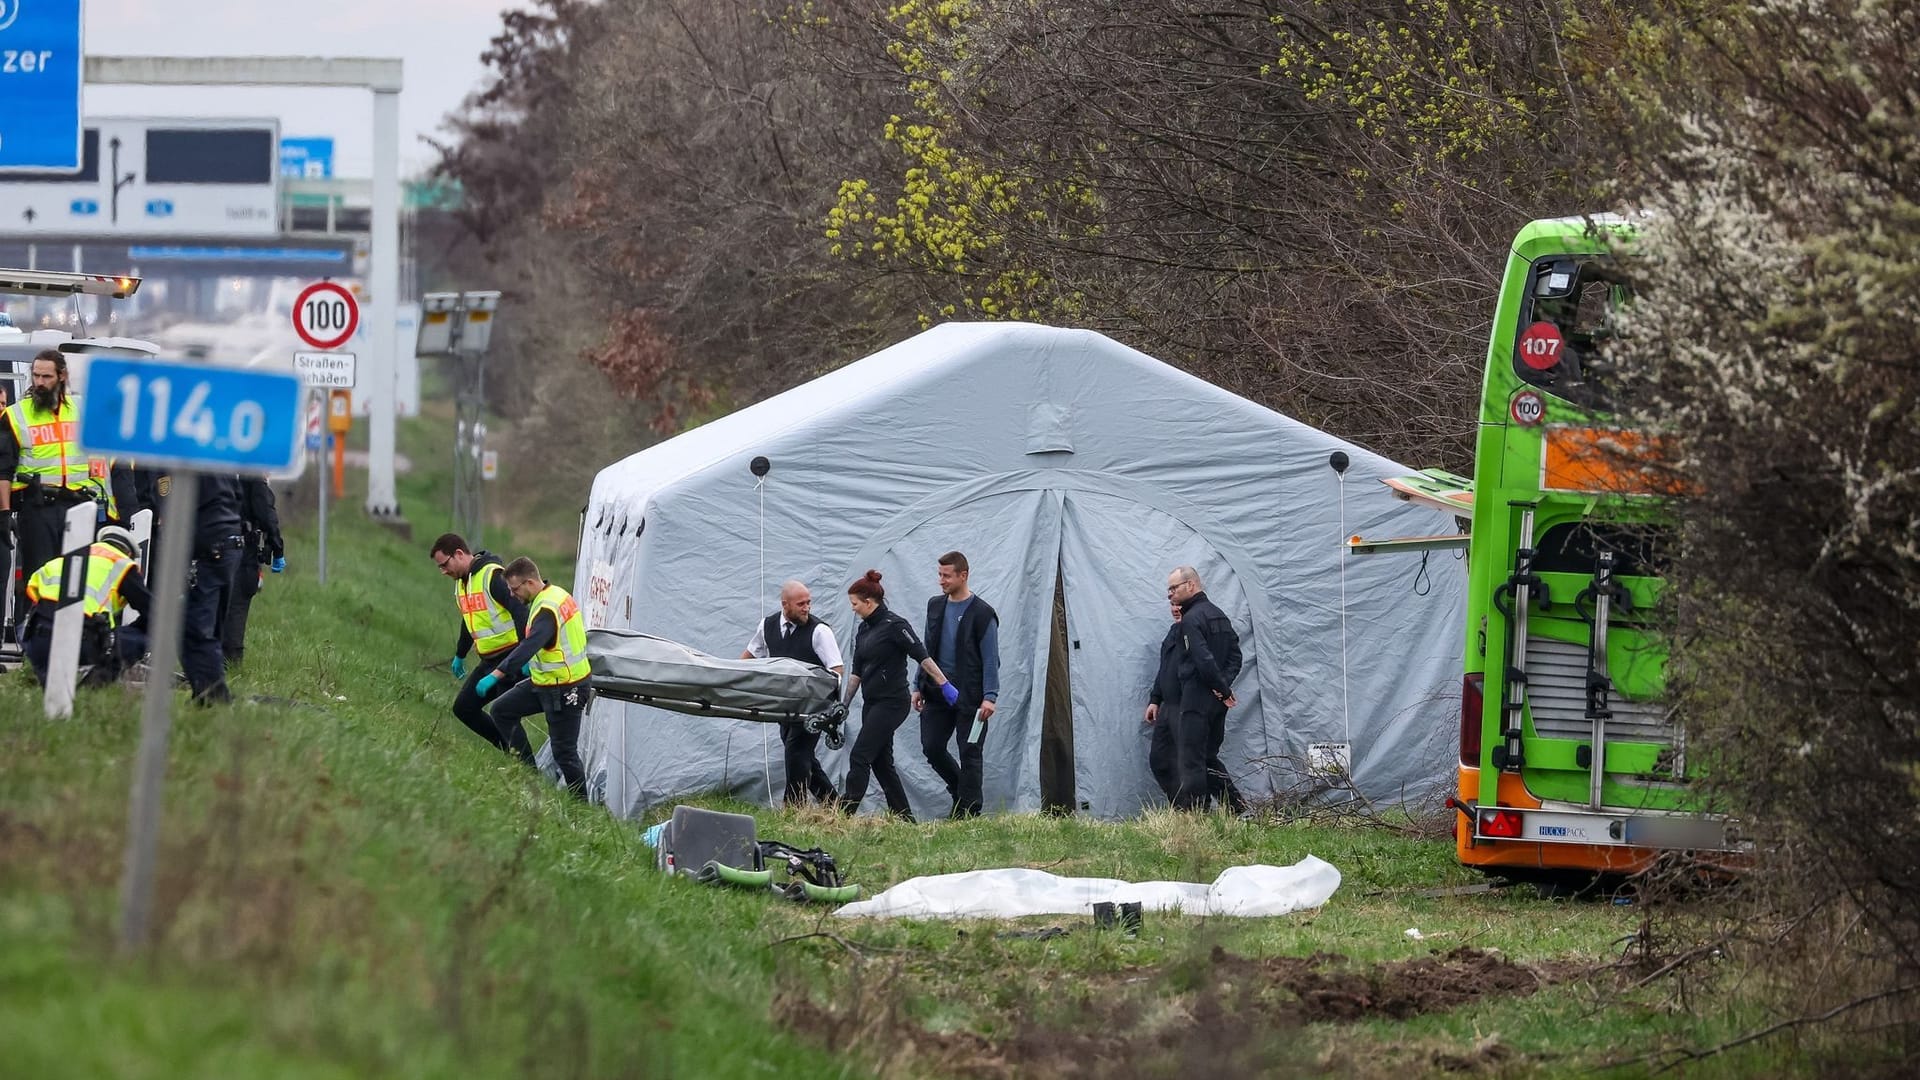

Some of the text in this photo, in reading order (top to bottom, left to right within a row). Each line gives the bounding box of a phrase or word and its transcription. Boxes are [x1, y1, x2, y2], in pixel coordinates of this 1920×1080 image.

[306, 300, 346, 330] 100
[1523, 338, 1560, 356] 107
[299, 356, 350, 370] Straßen-
[117, 374, 266, 452] 114.0
[1517, 402, 1540, 415] 100
